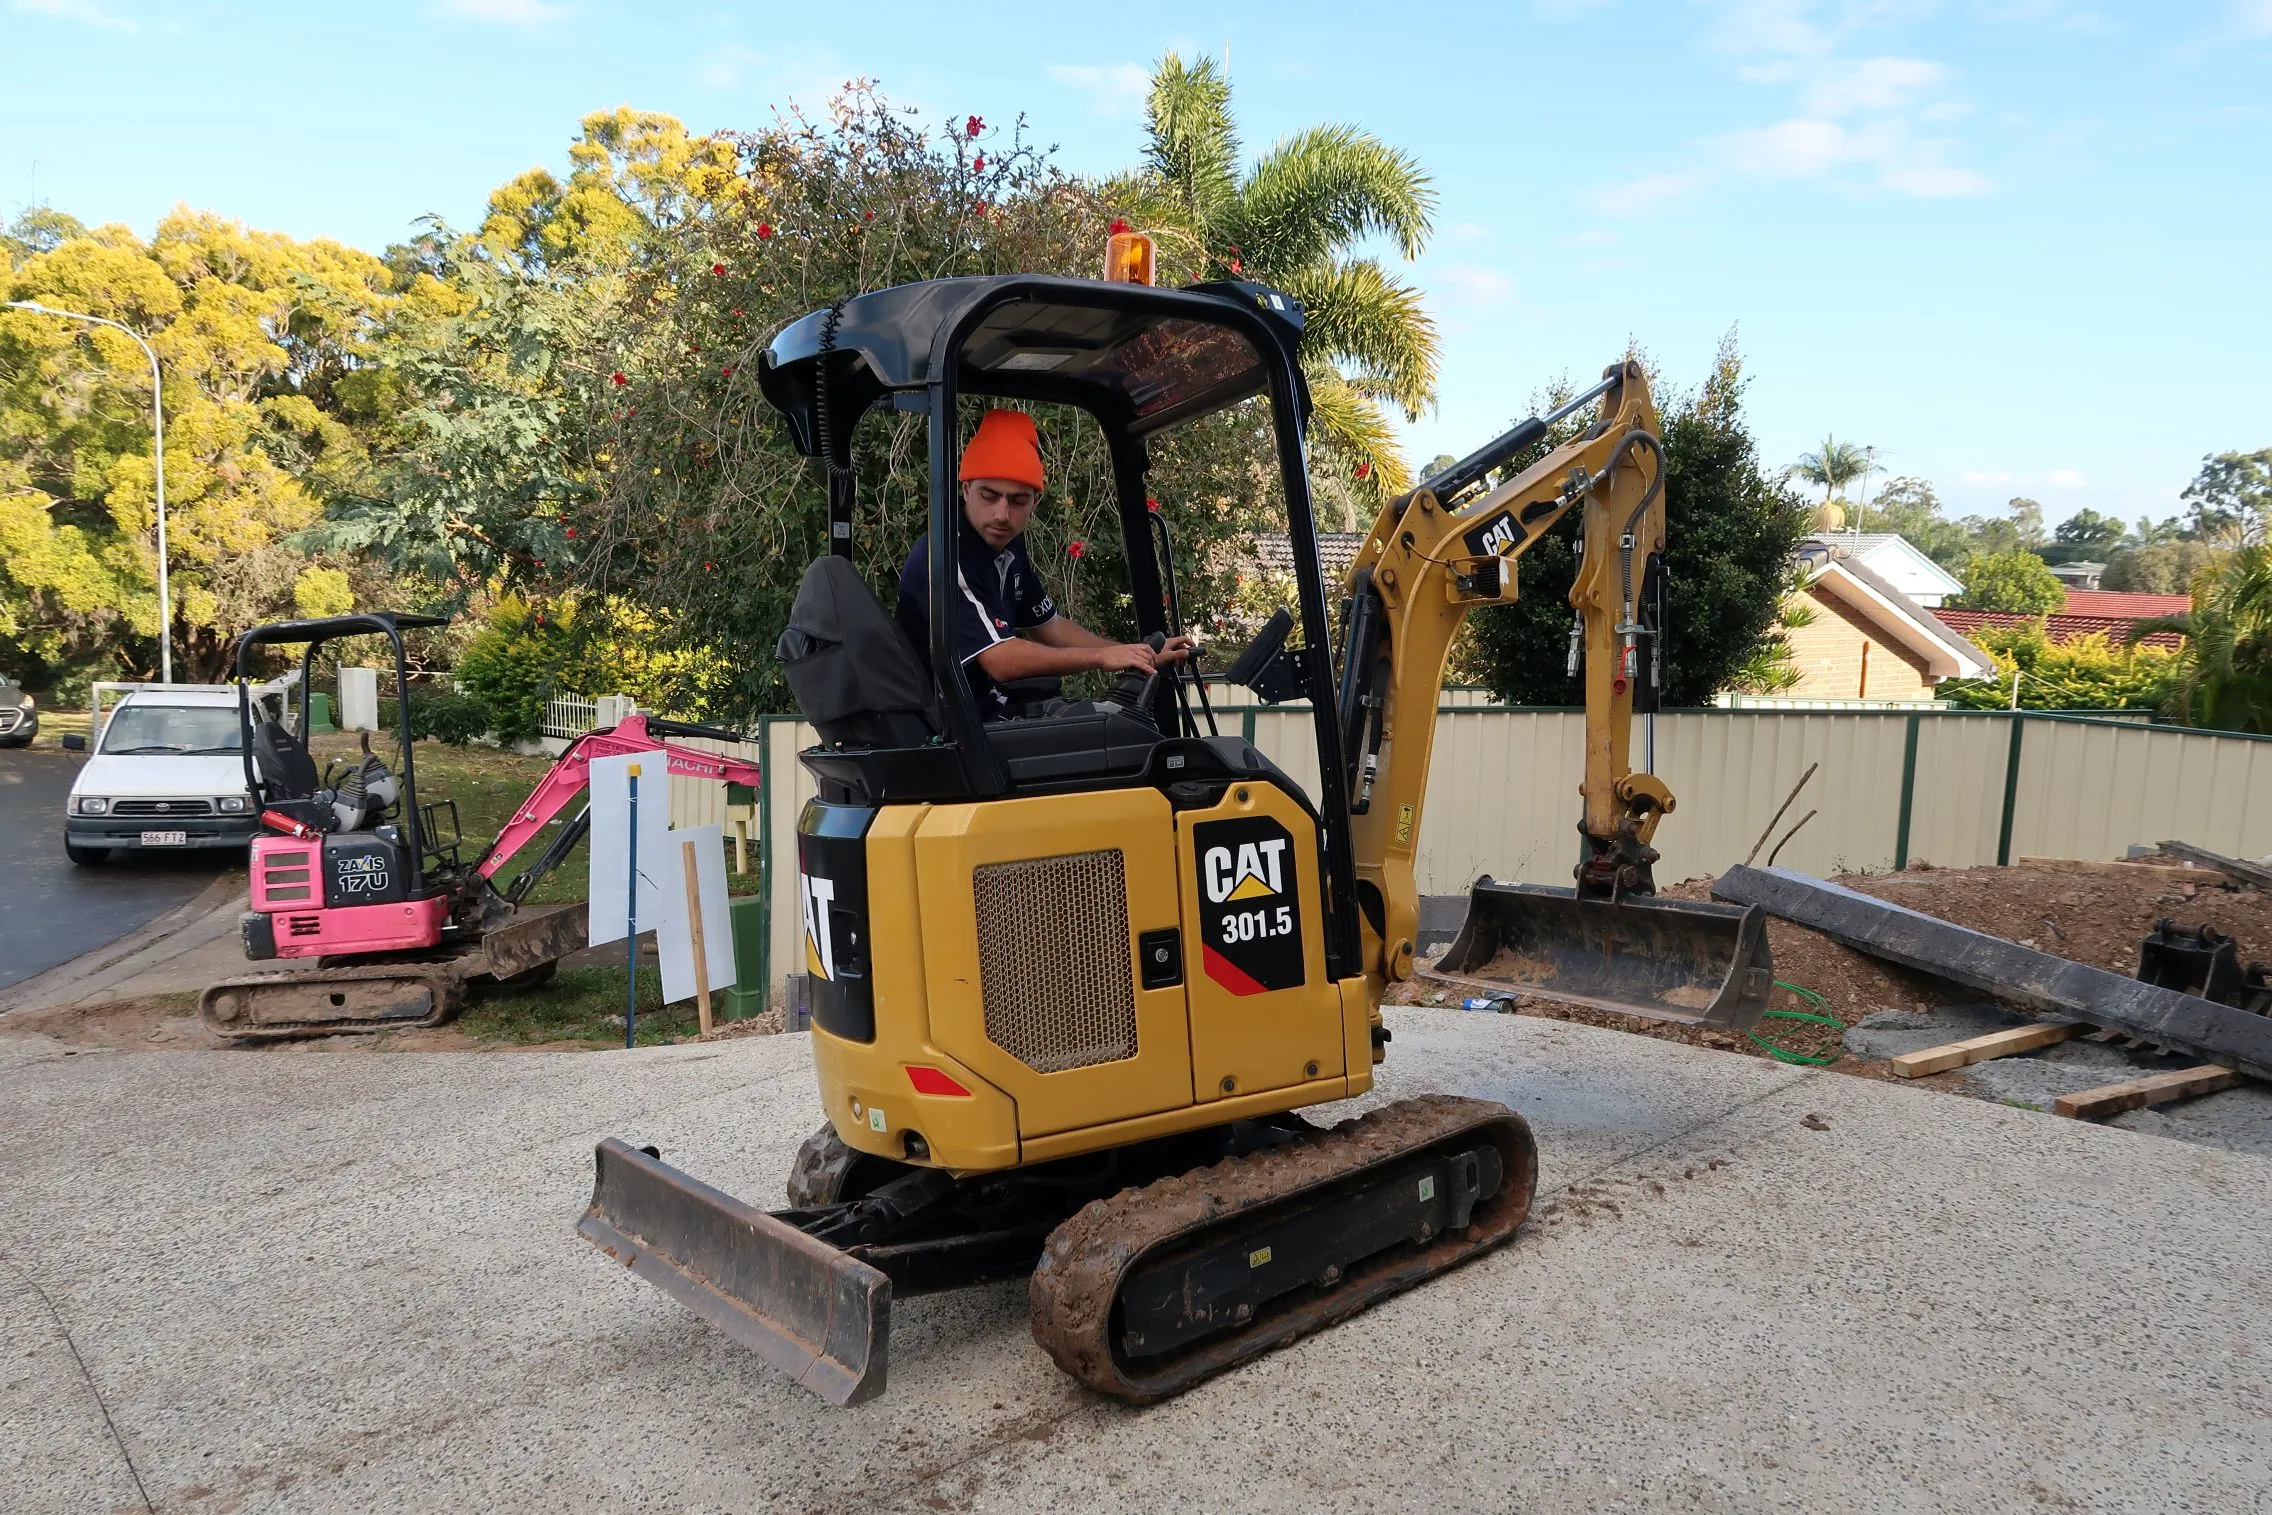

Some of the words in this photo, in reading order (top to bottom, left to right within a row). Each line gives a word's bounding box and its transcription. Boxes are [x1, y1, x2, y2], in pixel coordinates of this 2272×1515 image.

[1482, 516, 1515, 556] CAT
[1032, 595, 1053, 618] EXC
[668, 757, 713, 774] TACHI
[338, 855, 385, 873] ZAXIS
[1204, 838, 1286, 903] CAT
[339, 872, 389, 892] 17U
[800, 872, 835, 982] AT
[1221, 906, 1293, 944] 301.5
